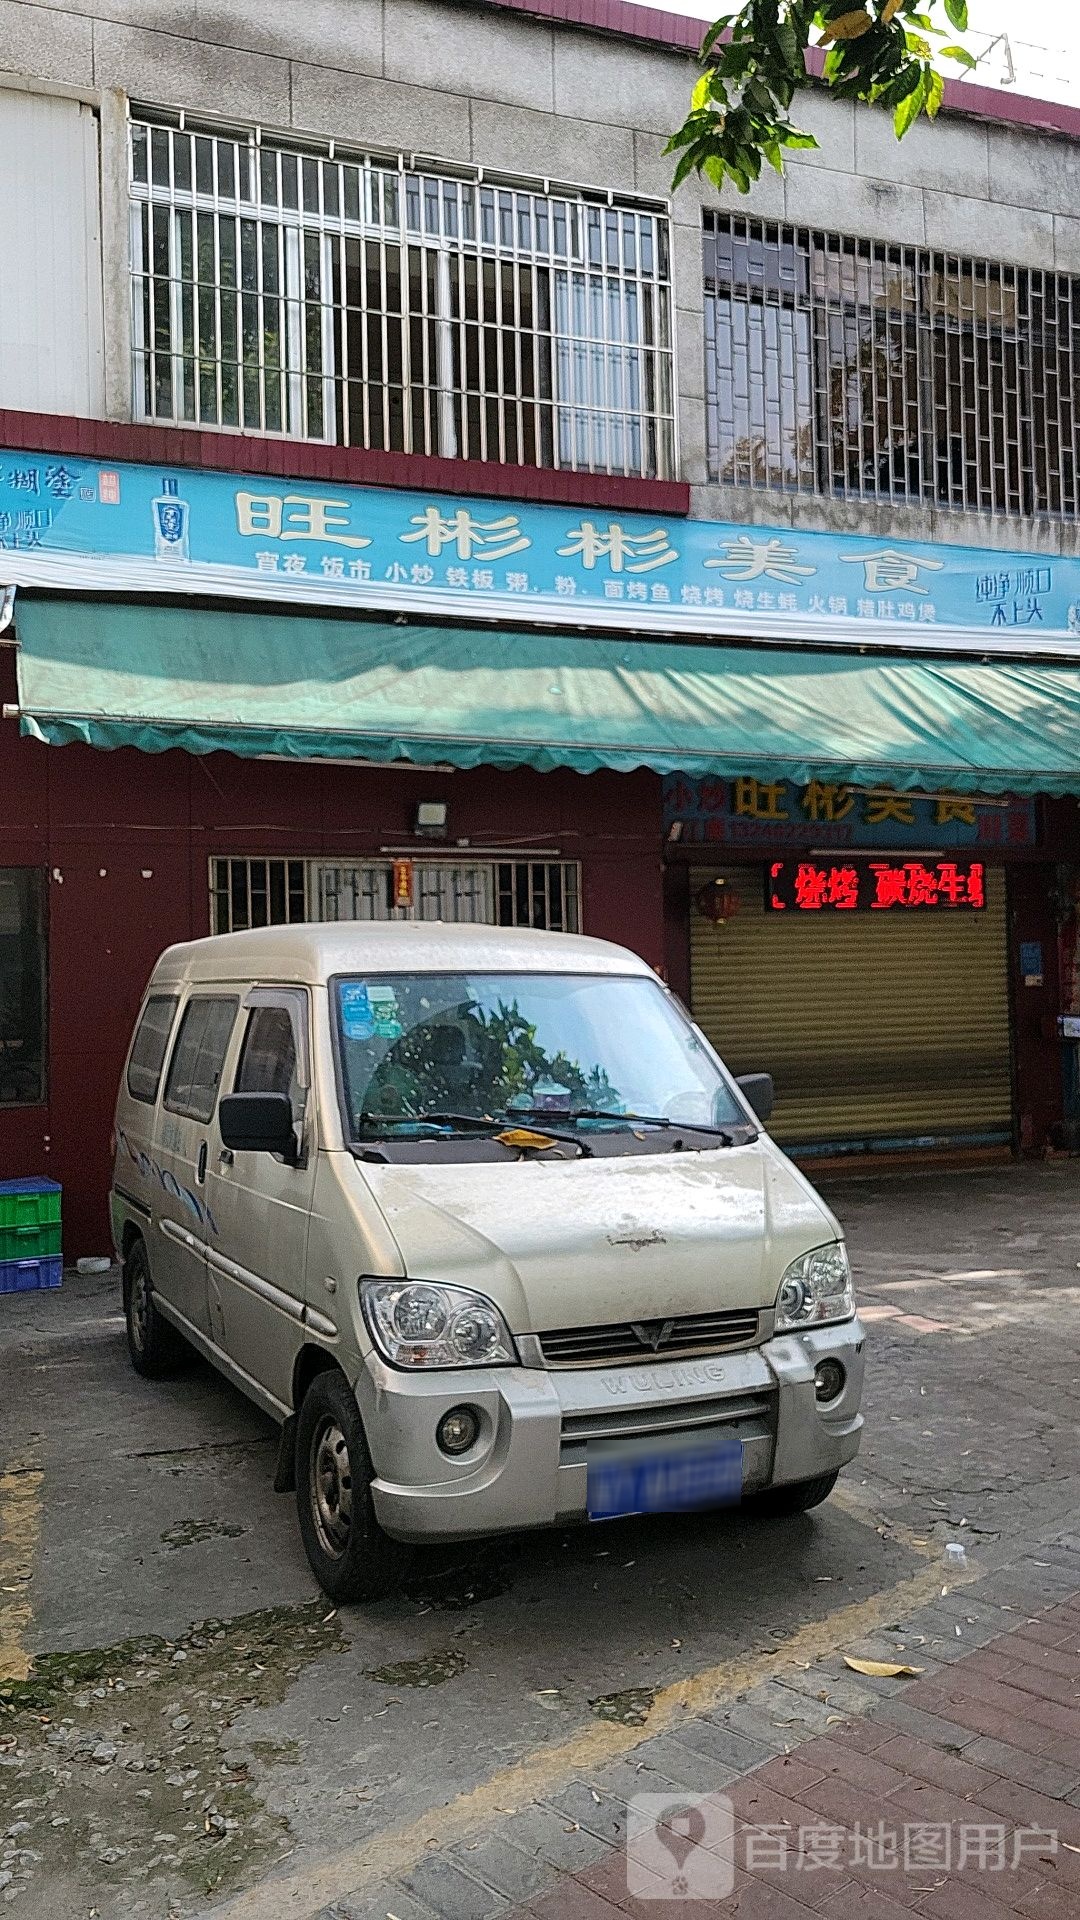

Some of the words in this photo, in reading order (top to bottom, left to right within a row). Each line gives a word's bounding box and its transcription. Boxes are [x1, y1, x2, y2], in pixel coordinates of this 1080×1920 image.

[235, 491, 944, 596] 旺彬彬美食
[321, 555, 371, 580] 饭市
[385, 561, 434, 585] 小炒
[446, 566, 494, 591] 铁板
[680, 583, 724, 607] 烧烤
[733, 588, 799, 614] 烧生蚝
[808, 593, 848, 616] 火锅
[856, 597, 936, 624] 猪肚鸡煲
[601, 1364, 725, 1395] WULING
